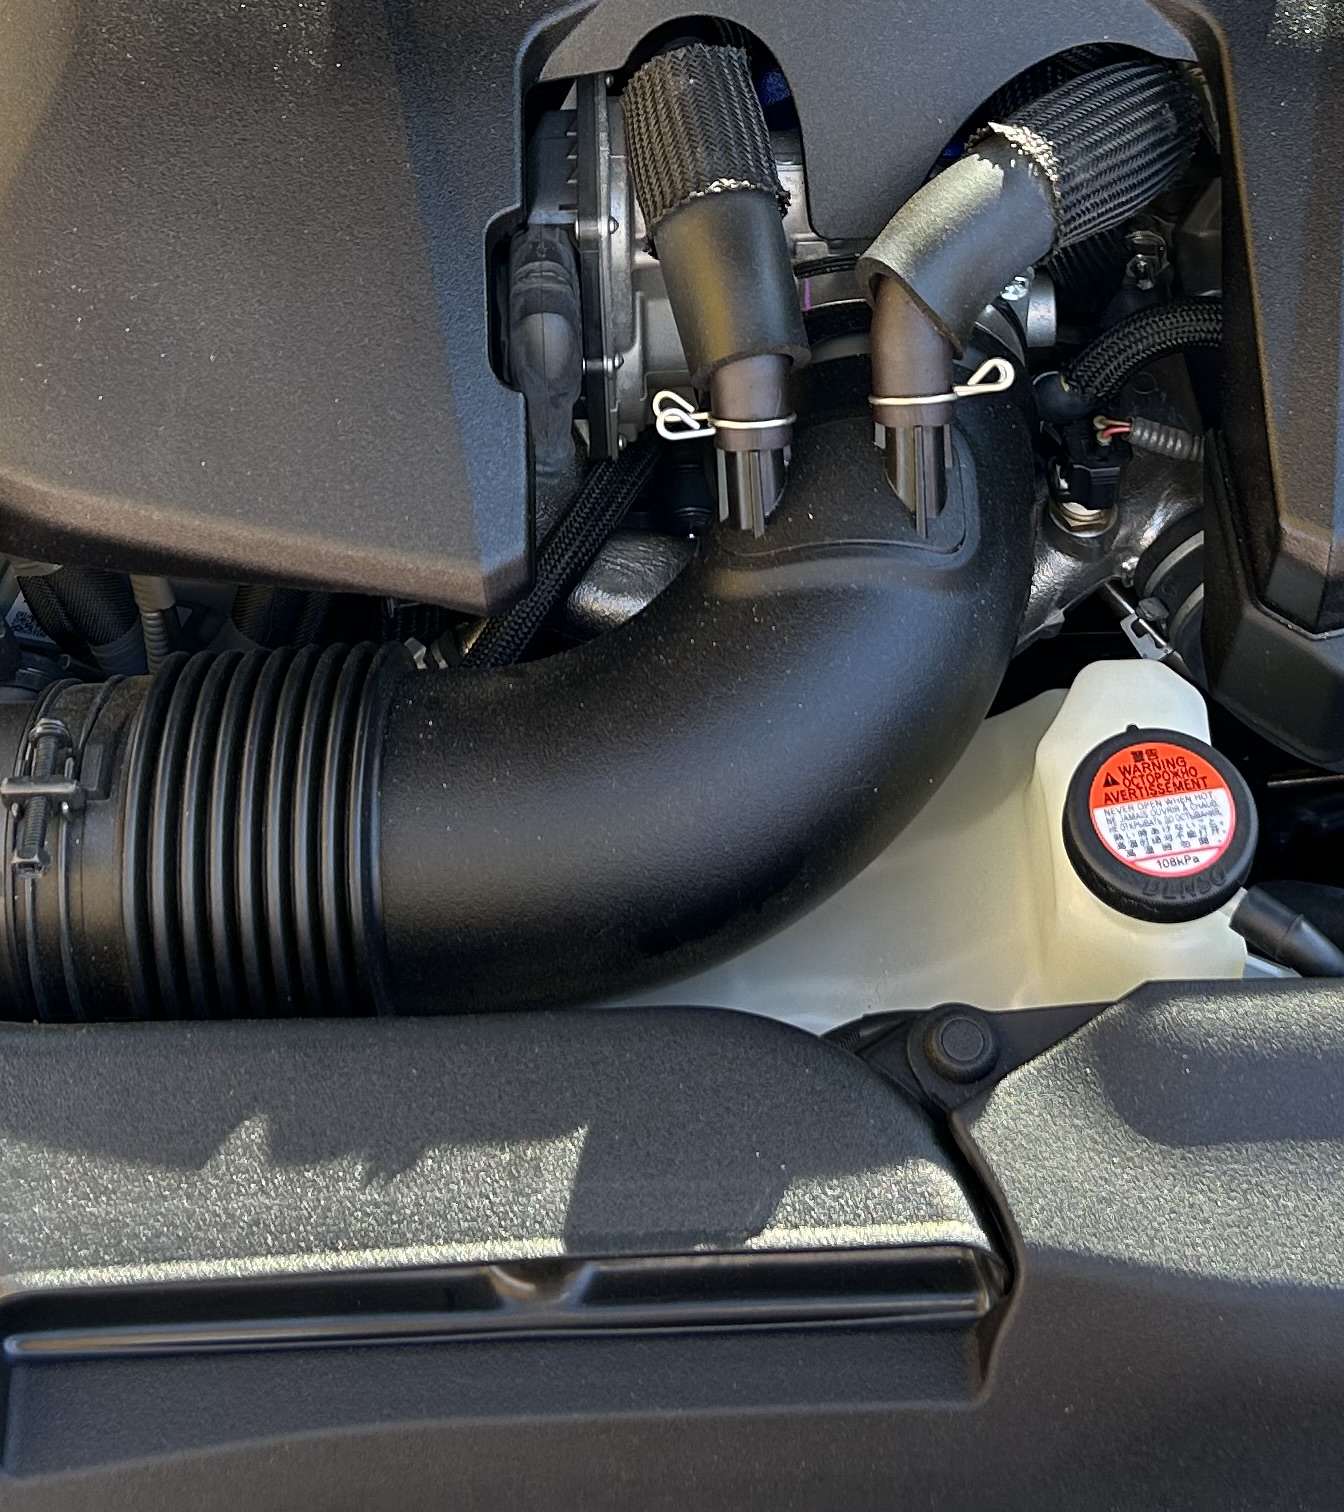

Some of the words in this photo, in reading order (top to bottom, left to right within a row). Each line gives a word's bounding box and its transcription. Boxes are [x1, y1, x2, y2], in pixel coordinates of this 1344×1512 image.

[1118, 756, 1187, 777] WARNING
[1122, 766, 1198, 788] ОСТОРОЖНО
[1103, 775, 1208, 805] AVERTISSEMENT
[1103, 804, 1135, 817] NEVER
[1137, 800, 1163, 811] OPEN
[1164, 795, 1192, 806] WHEN
[1156, 854, 1200, 869] 108kPa
[1142, 868, 1227, 899] DENSO
